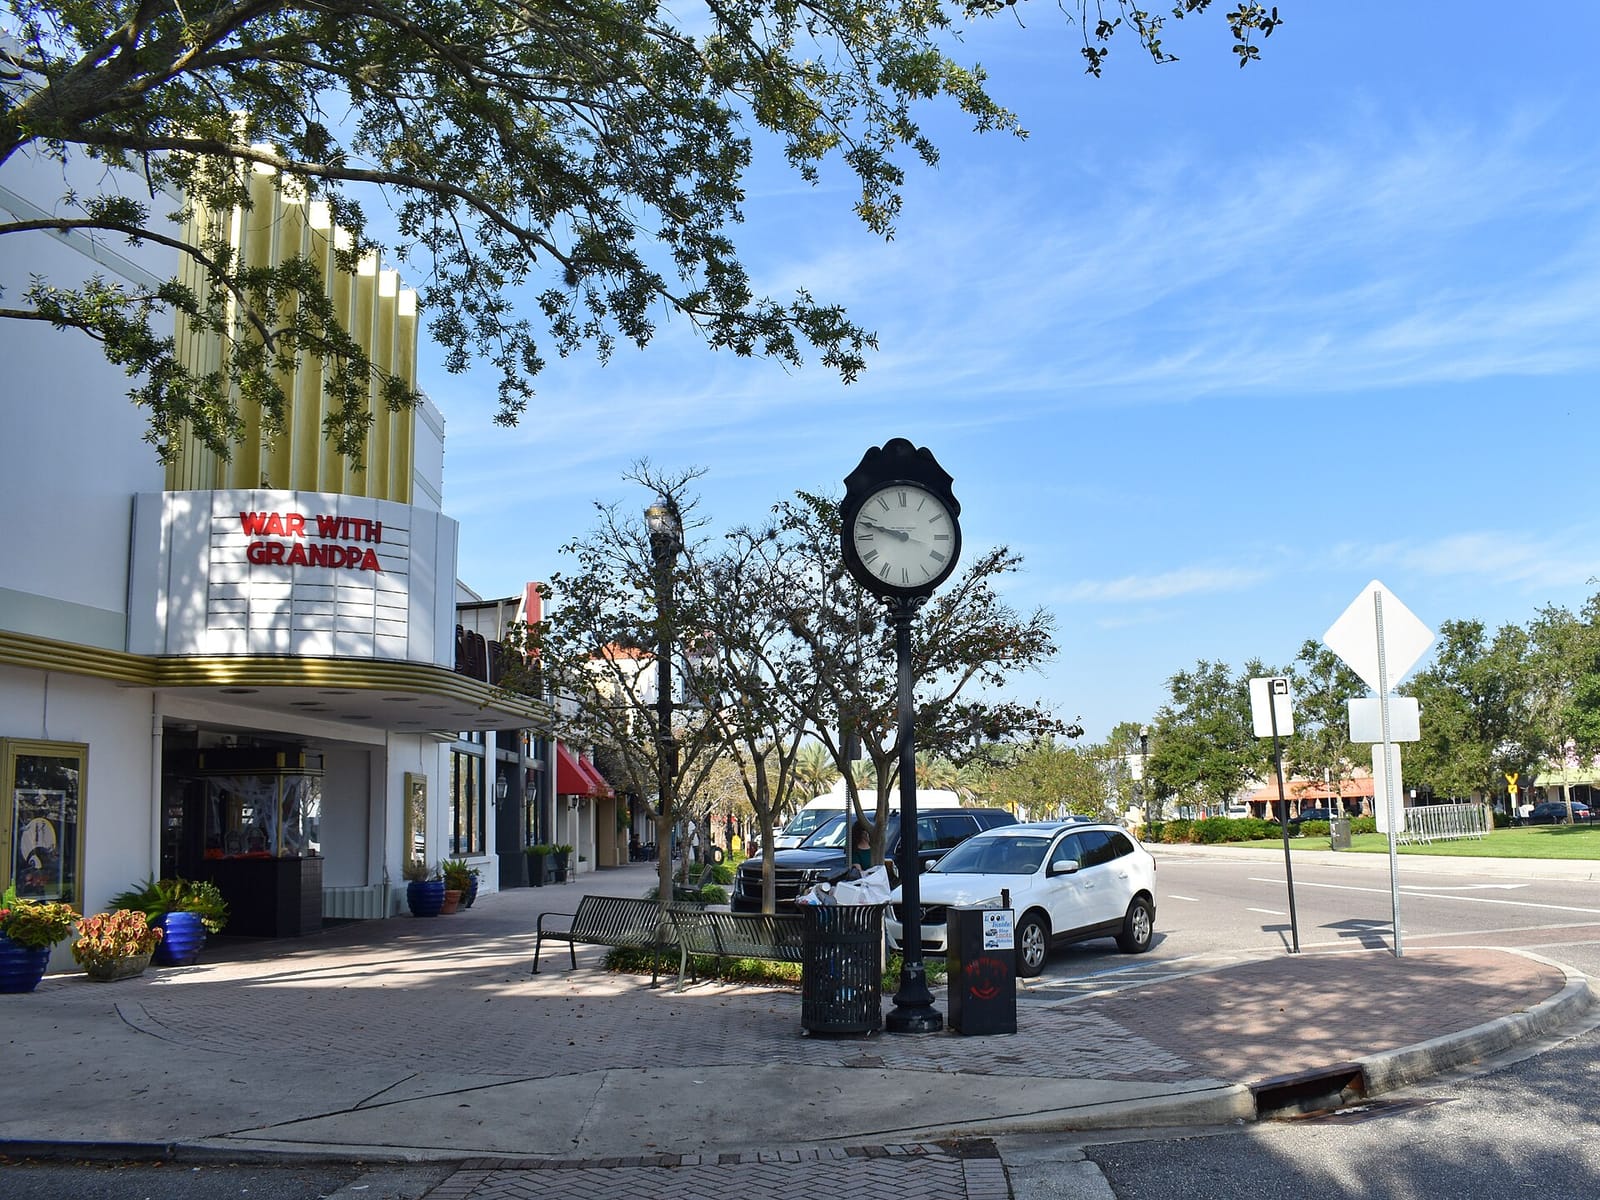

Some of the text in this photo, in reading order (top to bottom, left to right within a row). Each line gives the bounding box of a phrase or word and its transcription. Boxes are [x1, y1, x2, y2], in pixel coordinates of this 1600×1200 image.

[239, 511, 382, 544] WAR WITH
[246, 541, 380, 573] GRANDPA
